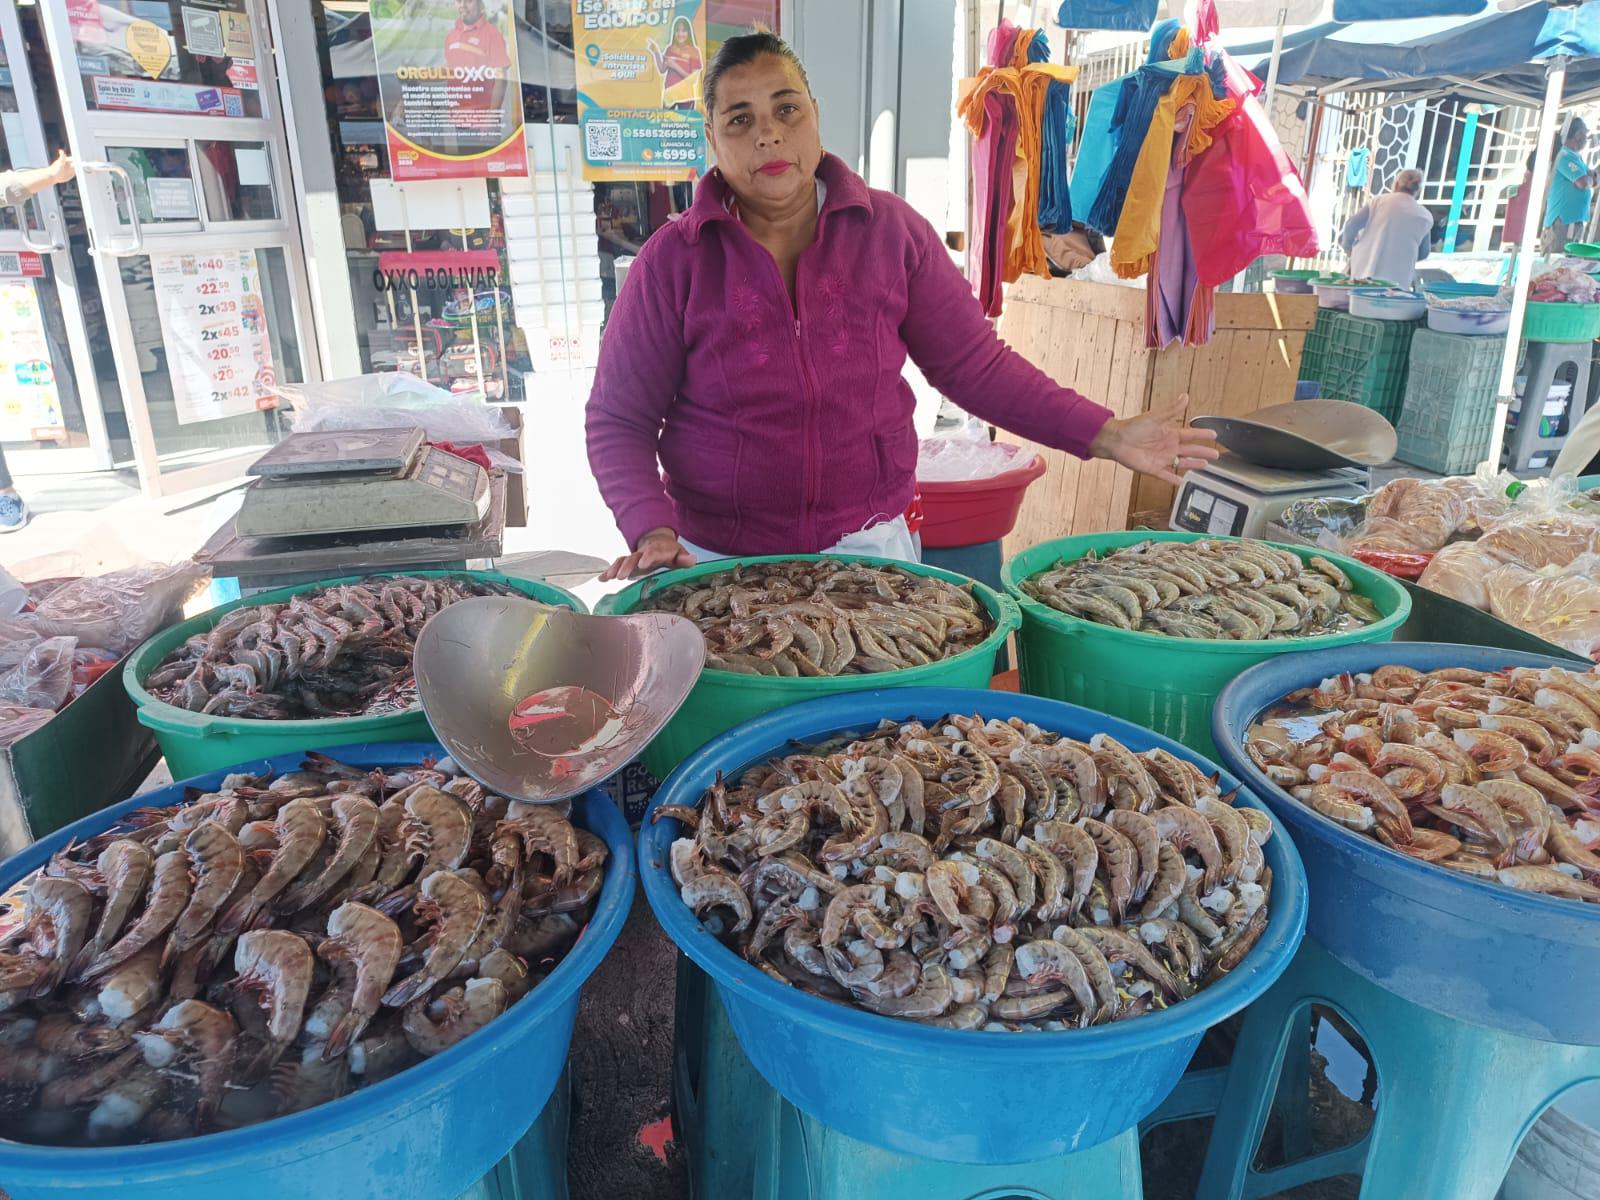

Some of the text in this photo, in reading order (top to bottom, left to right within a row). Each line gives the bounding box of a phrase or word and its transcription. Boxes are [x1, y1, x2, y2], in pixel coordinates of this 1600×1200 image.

[584, 9, 669, 29] EQUIPO!
[396, 65, 505, 83] ORGULLOXXOS
[632, 129, 698, 138] 5585266996
[373, 266, 498, 292] OXXO BOLIVAR
[626, 764, 648, 778] CO
